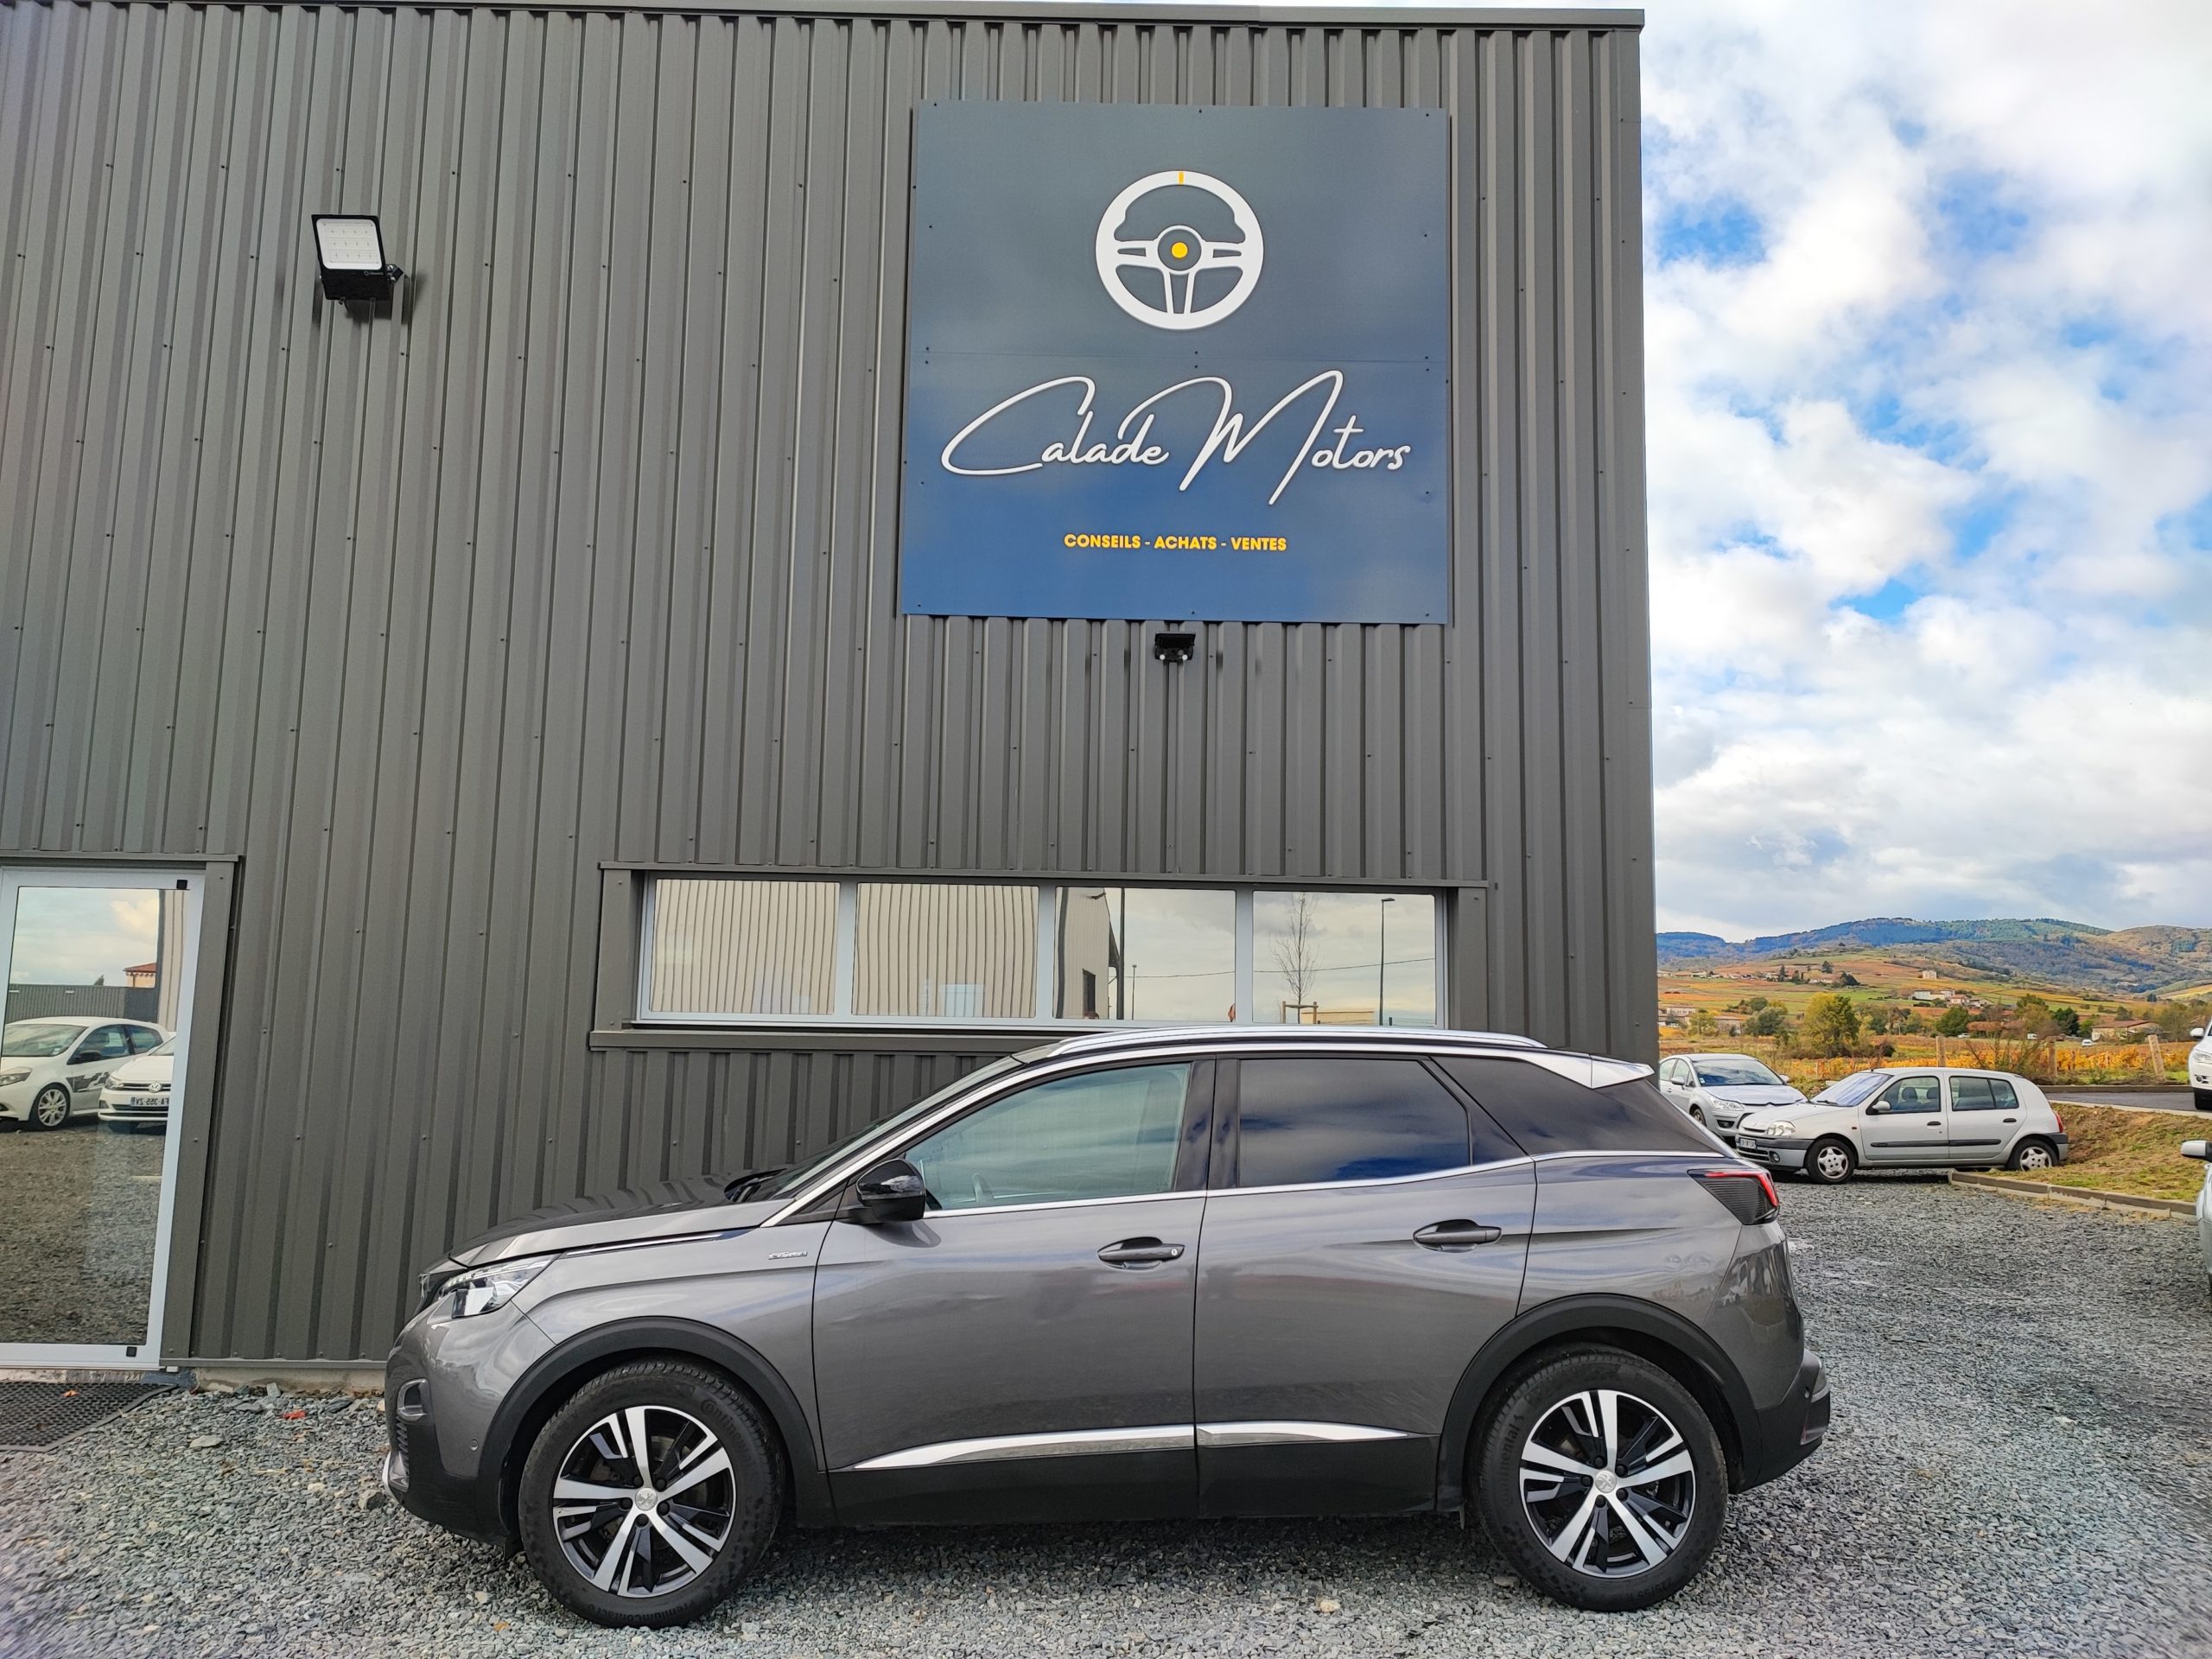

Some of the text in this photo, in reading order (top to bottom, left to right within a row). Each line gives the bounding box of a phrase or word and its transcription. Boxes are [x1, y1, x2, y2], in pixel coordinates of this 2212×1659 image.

[941, 370, 1411, 505] Calade Motors
[1064, 533, 1141, 550] CONSEILS
[1154, 536, 1217, 550] ACHATS
[1230, 537, 1287, 551] VENTES
